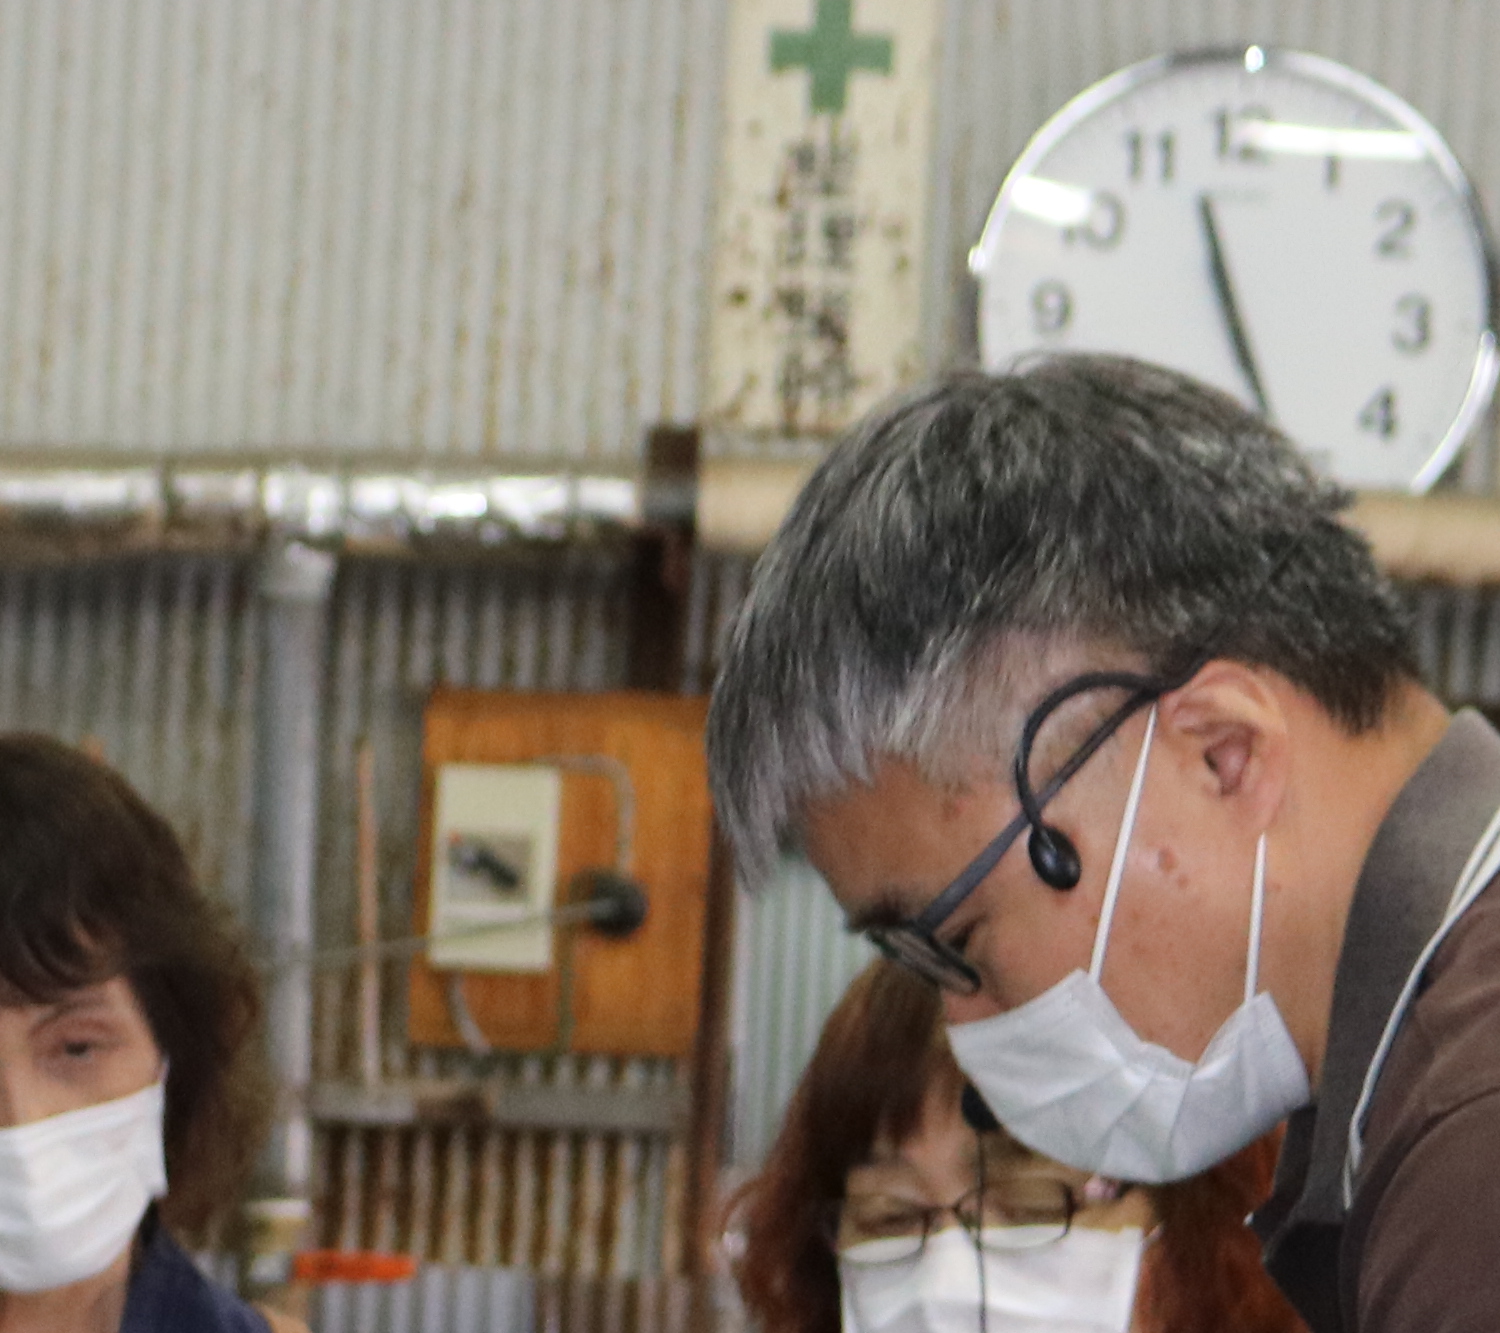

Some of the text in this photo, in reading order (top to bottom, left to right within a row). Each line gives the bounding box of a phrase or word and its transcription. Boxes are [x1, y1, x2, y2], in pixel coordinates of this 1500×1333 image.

[1126, 131, 1174, 182] 11
[1214, 106, 1273, 163] 12
[1373, 200, 1413, 257] 2
[1032, 280, 1073, 334] 9
[1393, 294, 1431, 353] 3
[1358, 388, 1399, 440] 4
